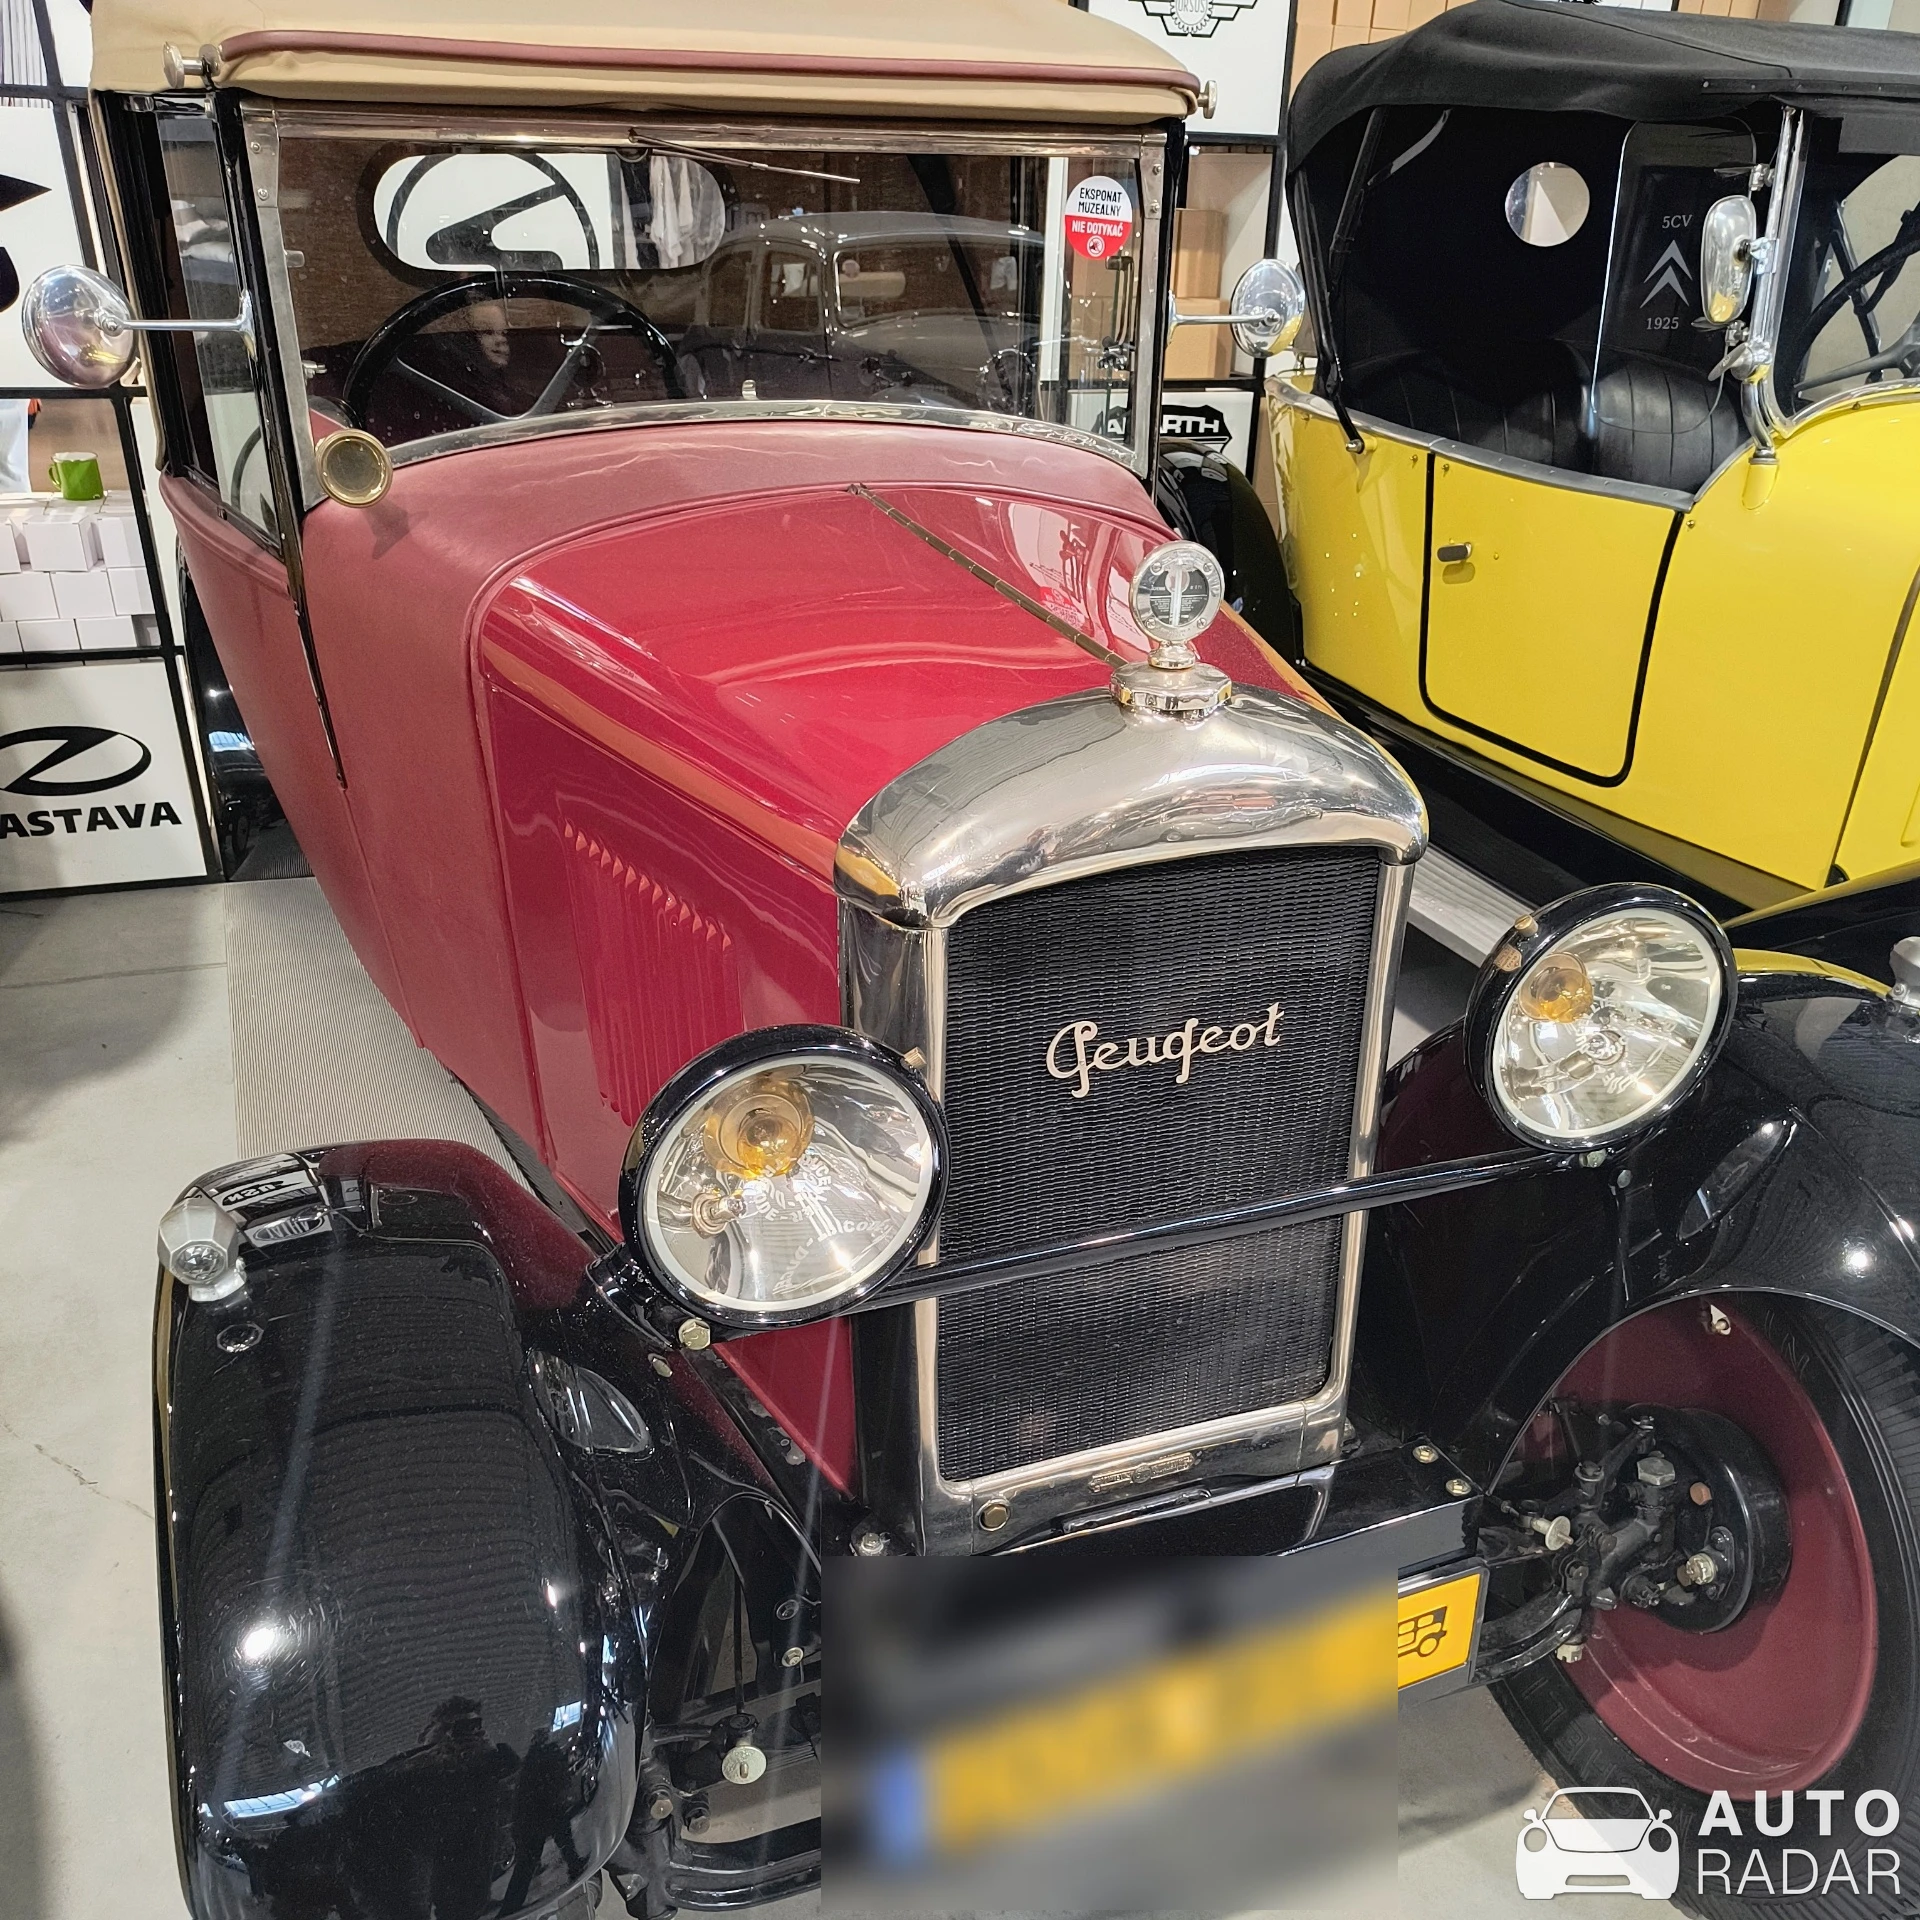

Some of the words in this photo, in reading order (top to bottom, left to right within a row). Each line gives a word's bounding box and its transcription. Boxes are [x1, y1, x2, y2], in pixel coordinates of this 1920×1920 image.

[1080, 187, 1122, 203] EKSPONAT
[1078, 201, 1121, 217] MUZEALNY
[1072, 220, 1086, 233] NIE
[1086, 222, 1124, 237] DOTYKAĆ
[1662, 214, 1692, 229] 5CV
[1646, 316, 1679, 330] 1925
[1099, 414, 1220, 435] ARTH
[1046, 1002, 1285, 1099] Peugeot
